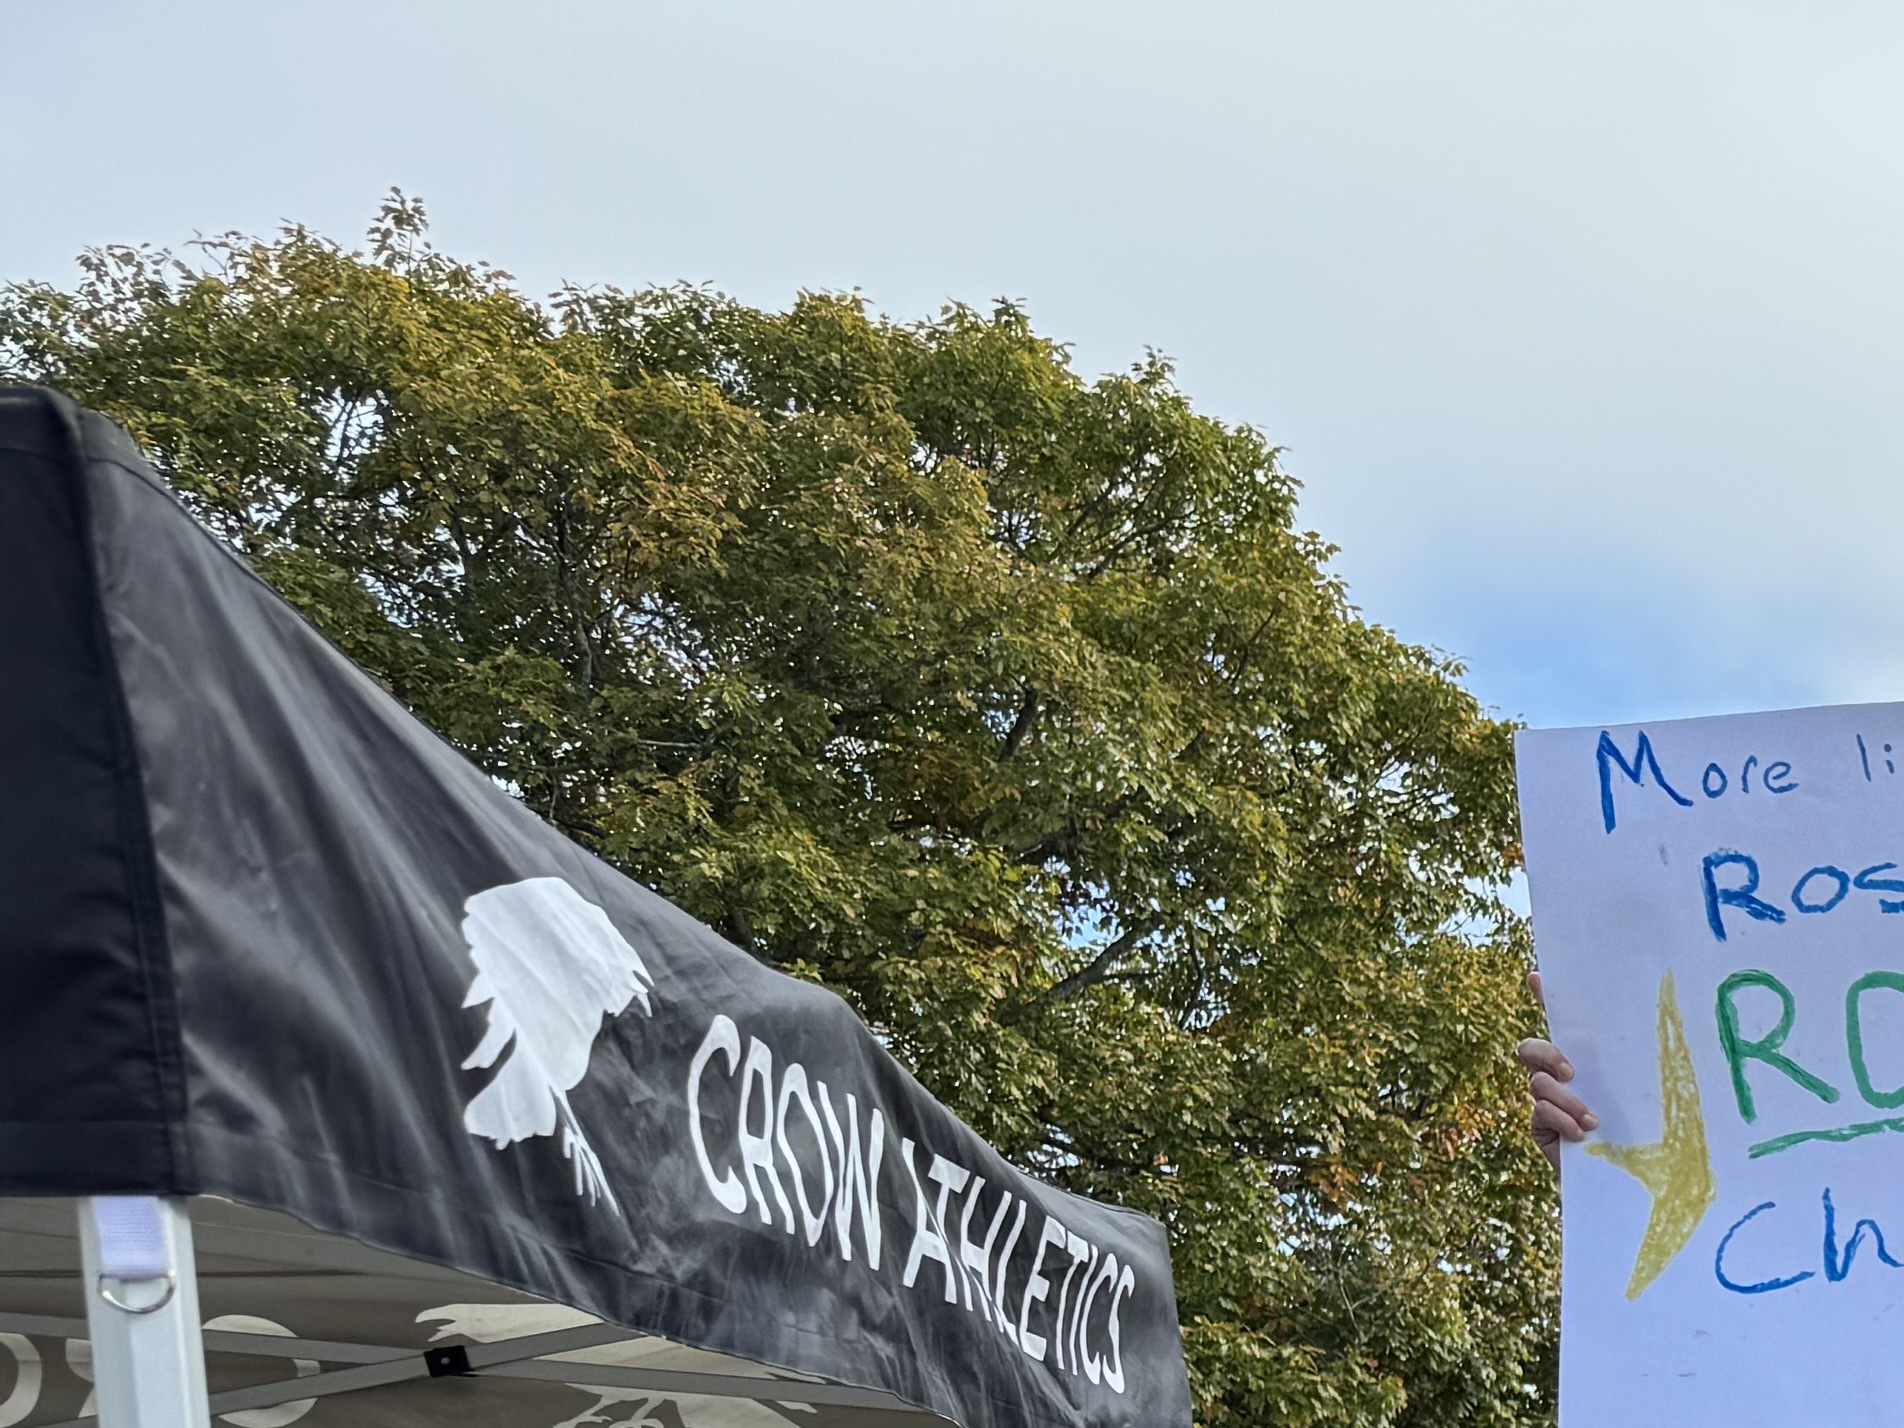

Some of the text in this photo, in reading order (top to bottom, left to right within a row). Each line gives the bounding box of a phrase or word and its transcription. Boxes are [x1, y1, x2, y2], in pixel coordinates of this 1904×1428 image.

[1597, 730, 1799, 834] More
[687, 1014, 1136, 1395] CROW ATHLETICS
